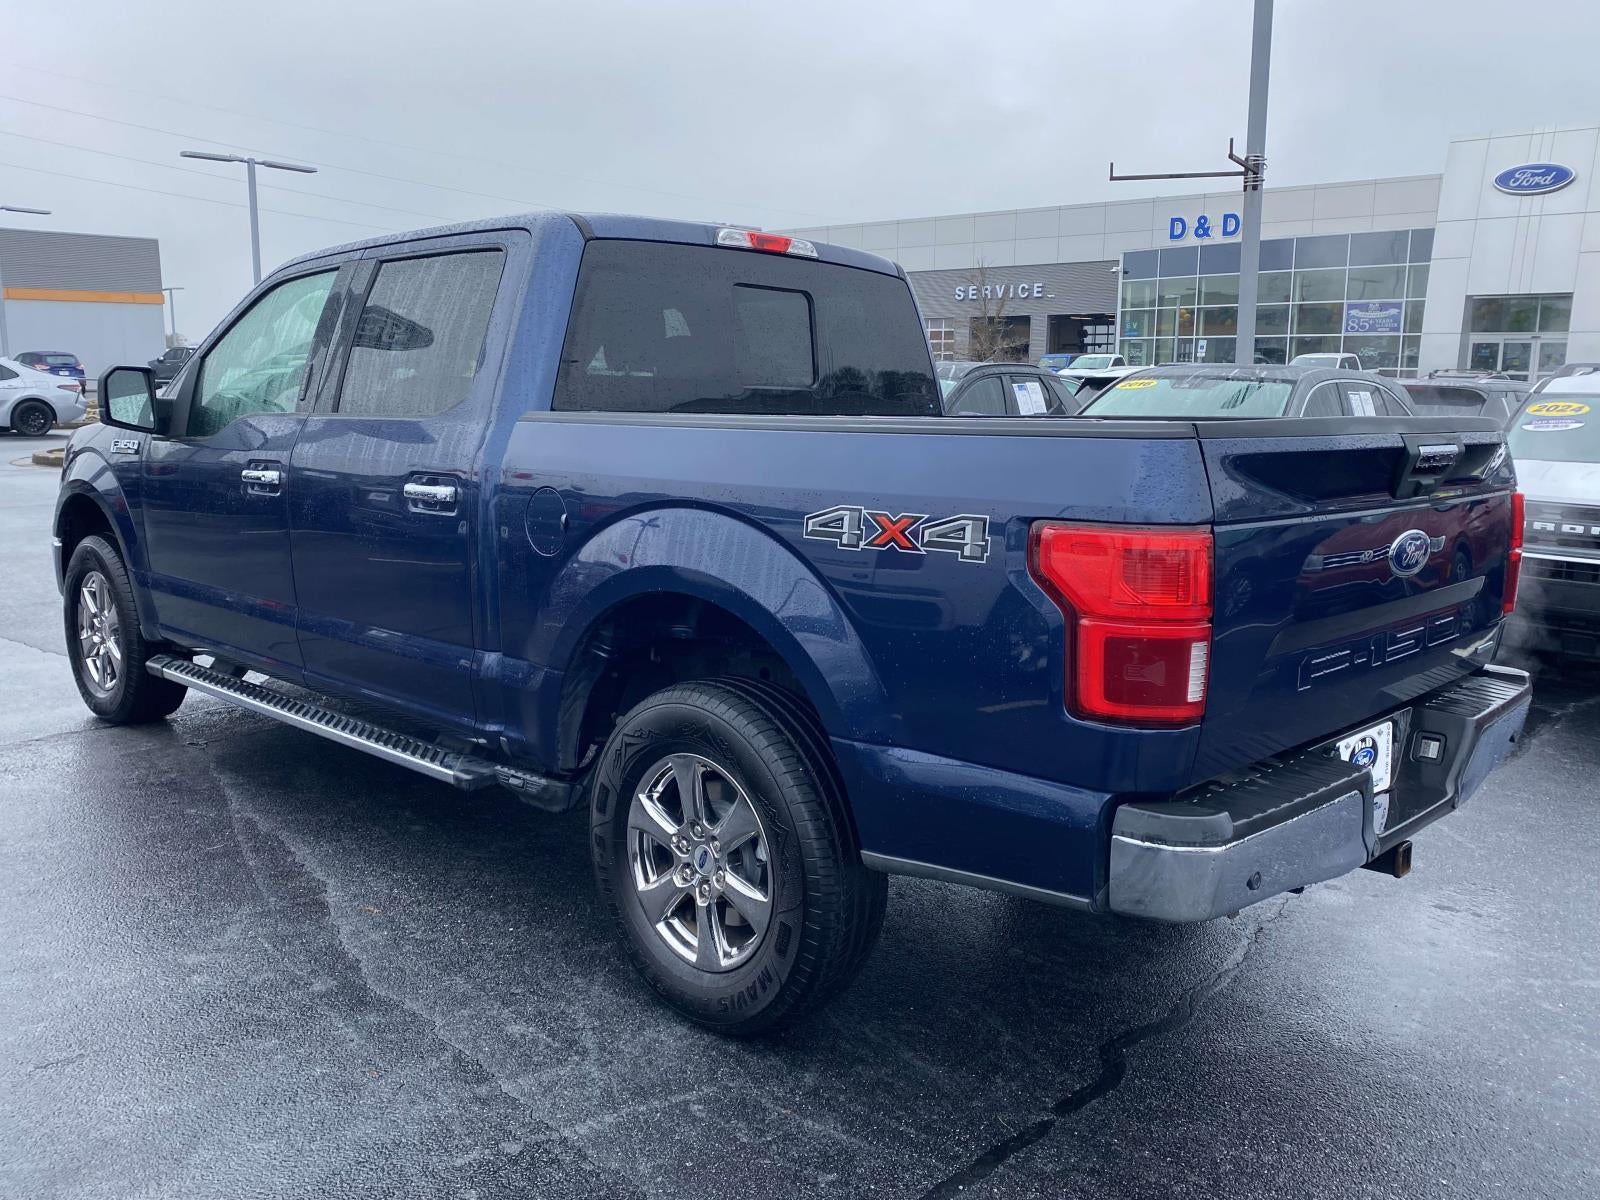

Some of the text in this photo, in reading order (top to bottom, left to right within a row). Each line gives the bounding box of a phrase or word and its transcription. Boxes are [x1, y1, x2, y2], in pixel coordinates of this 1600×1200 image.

[1510, 169, 1557, 187] Ford
[1169, 213, 1240, 239] D & D
[955, 283, 1043, 300] SERVICE
[1532, 404, 1585, 413] 2024
[1524, 521, 1600, 535] RO
[1403, 539, 1426, 567] Ford
[1298, 610, 1460, 691] F-150
[719, 965, 774, 1015] MAVIS
